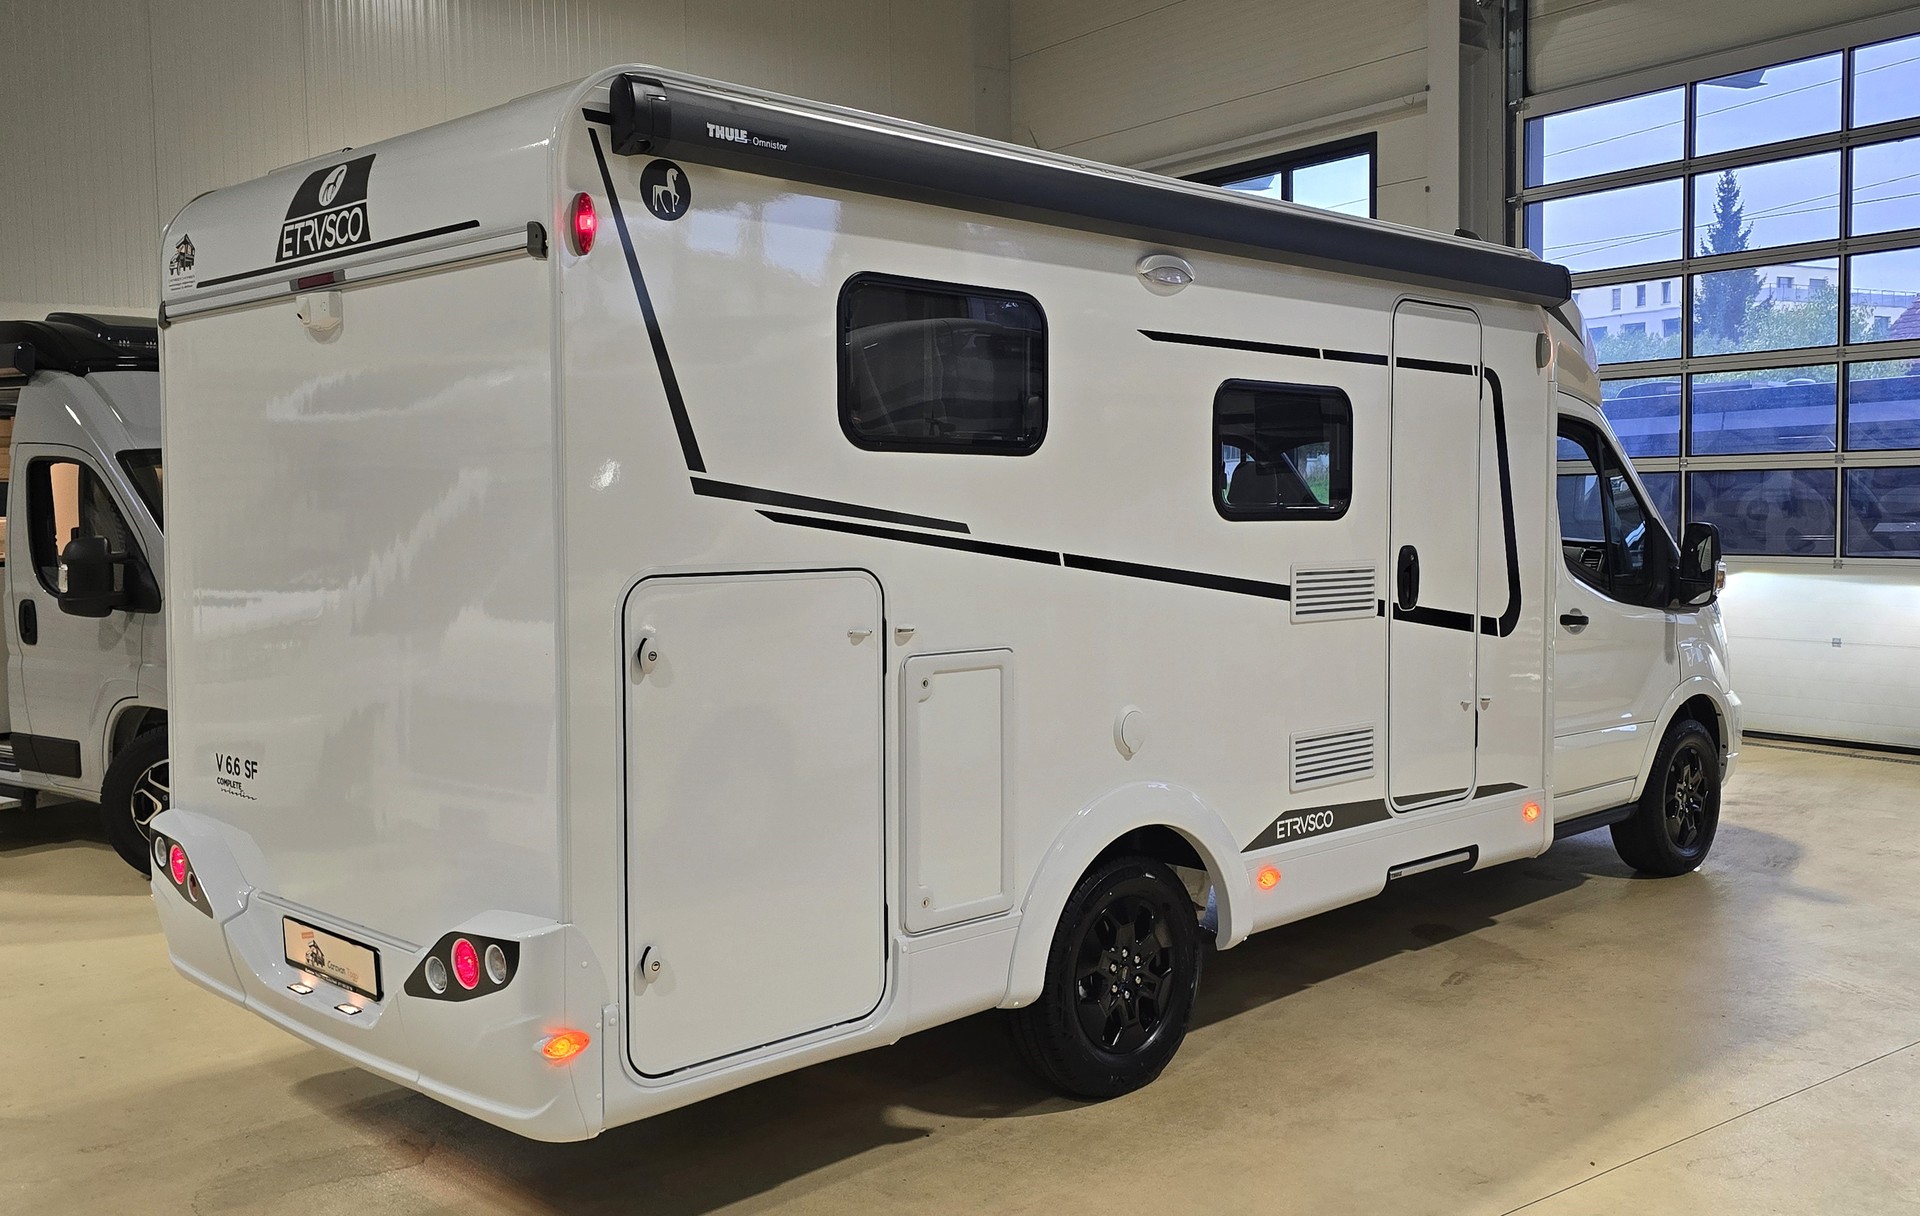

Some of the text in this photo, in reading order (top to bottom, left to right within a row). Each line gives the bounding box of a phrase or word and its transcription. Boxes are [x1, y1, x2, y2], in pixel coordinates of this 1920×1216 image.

[707, 121, 788, 152] THULE Omnistor
[215, 752, 258, 780] V 6.6 SF
[216, 776, 242, 790] COMPLETE
